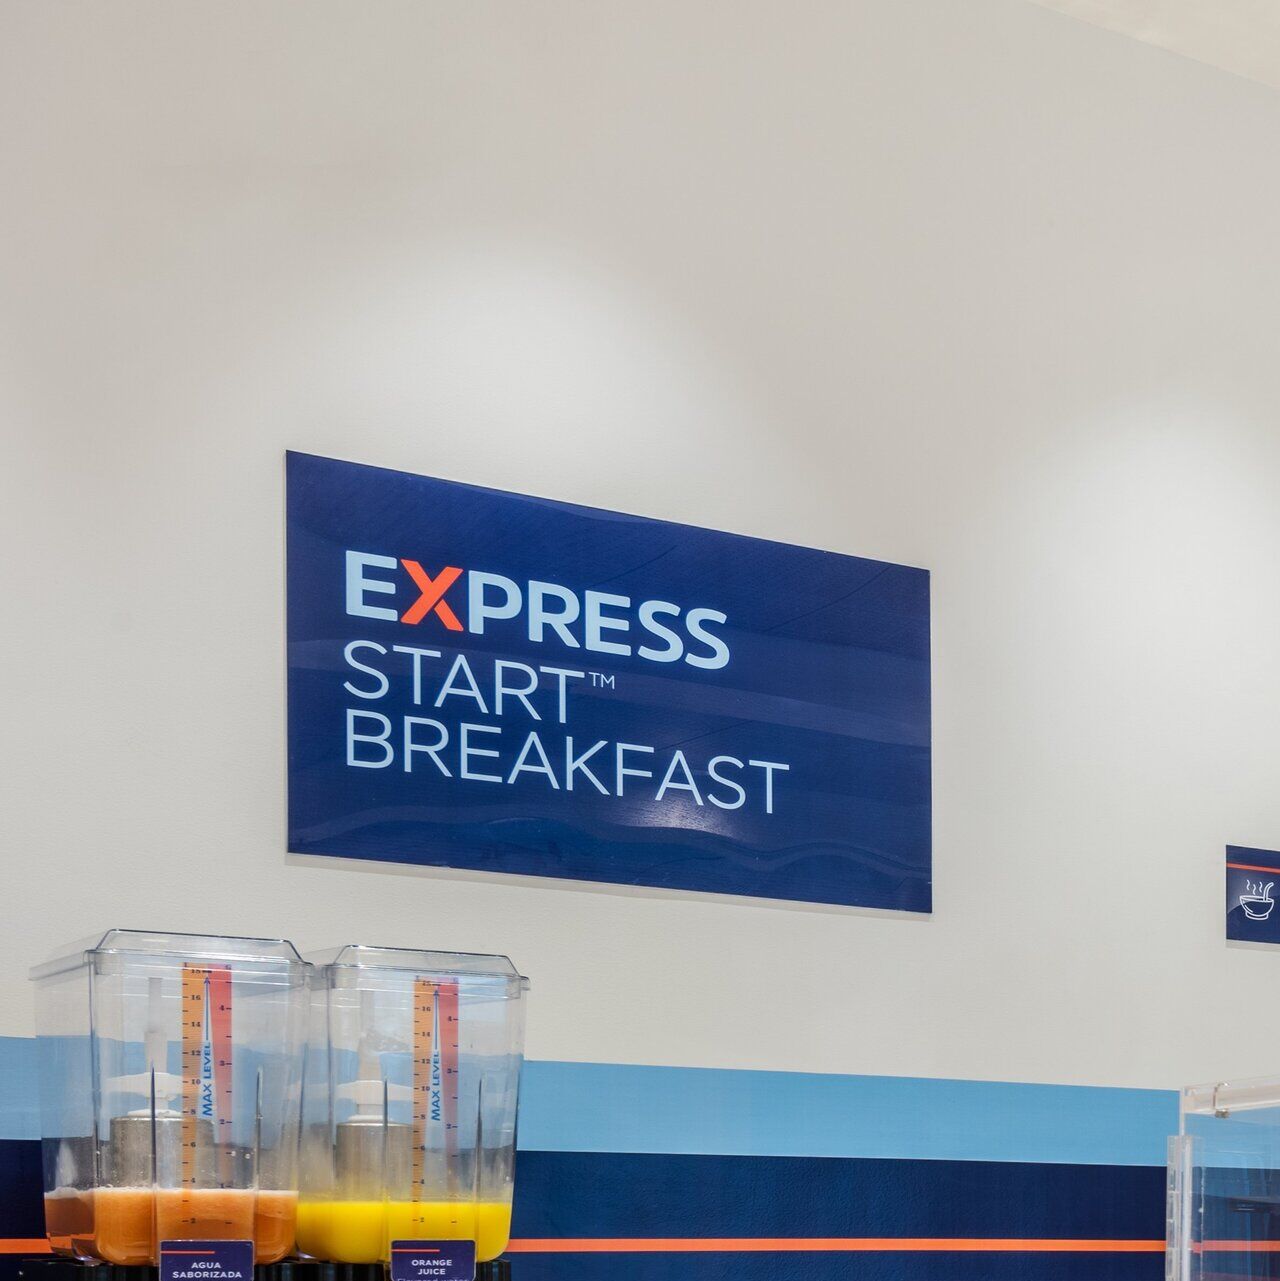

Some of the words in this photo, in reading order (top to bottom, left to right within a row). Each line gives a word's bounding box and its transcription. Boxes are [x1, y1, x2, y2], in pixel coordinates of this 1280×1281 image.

[345, 549, 731, 671] EXPRESS
[346, 708, 790, 814] BREAKFAST
[203, 1042, 212, 1079] LEVEL
[432, 1053, 440, 1086] LEVEL
[202, 1083, 212, 1116] MAX
[431, 1090, 440, 1121] MAX
